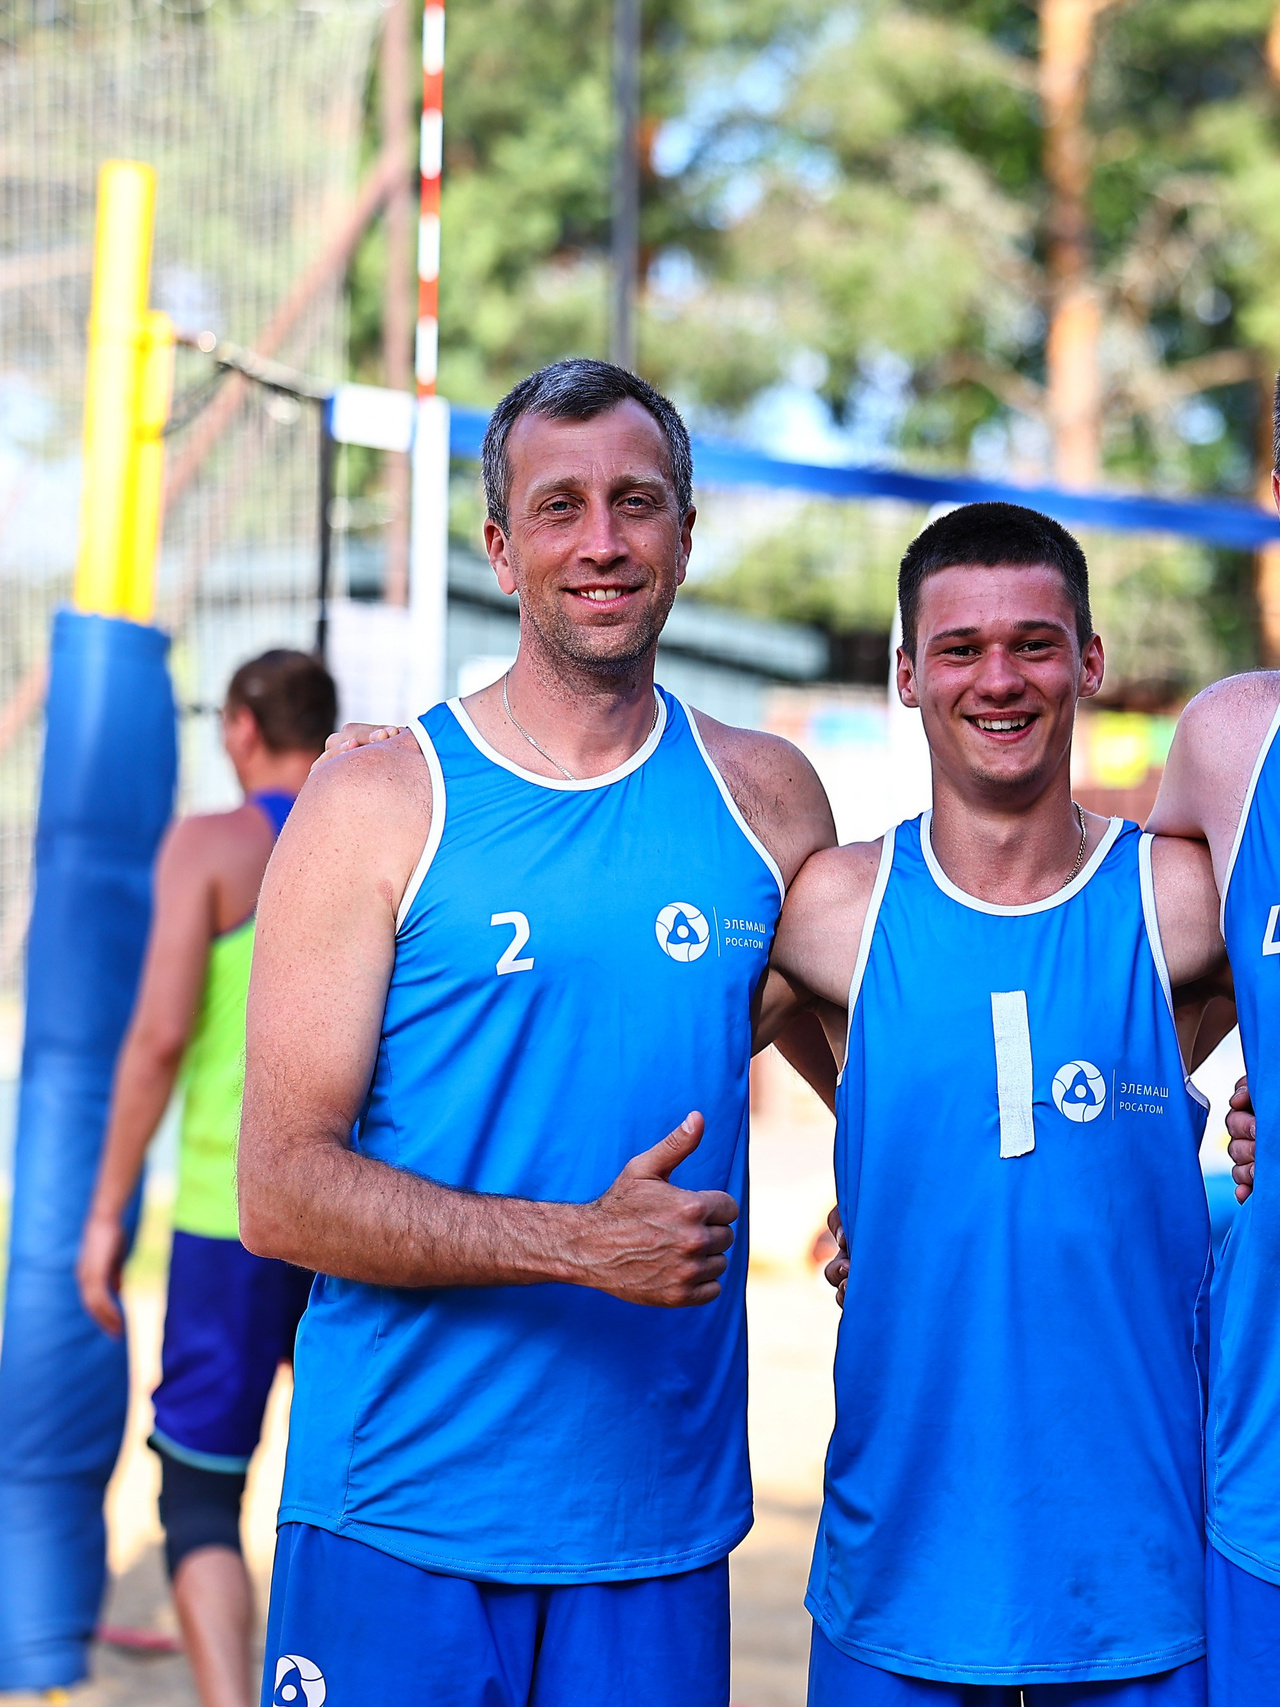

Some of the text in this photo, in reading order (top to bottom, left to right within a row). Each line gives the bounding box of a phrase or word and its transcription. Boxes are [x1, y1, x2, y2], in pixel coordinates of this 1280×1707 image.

[723, 918, 766, 934] ЭЛЕМАШ
[490, 910, 535, 976] 2
[725, 937, 764, 949] РОСАТОМ
[1120, 1082, 1169, 1098] ЭЛЕМАШ
[1119, 1101, 1164, 1114] РОСАТОМ
